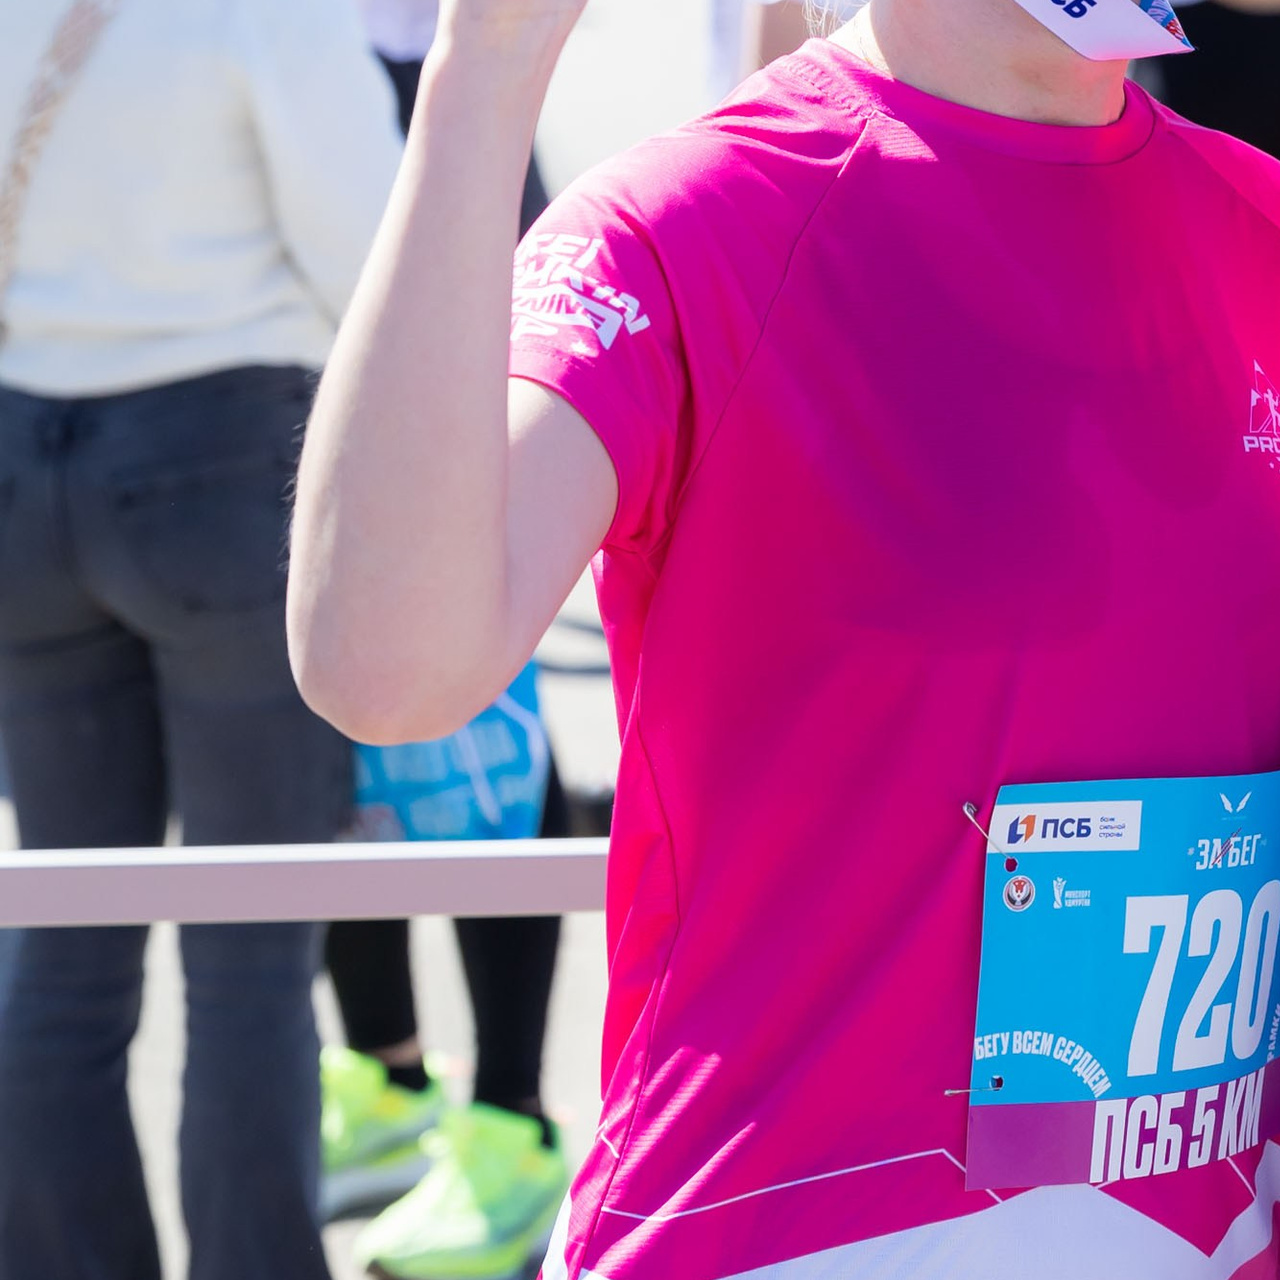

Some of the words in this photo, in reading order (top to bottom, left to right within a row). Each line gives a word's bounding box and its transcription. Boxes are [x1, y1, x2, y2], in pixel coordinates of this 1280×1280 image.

[1041, 817, 1092, 839] ПСБ
[974, 1031, 1010, 1061] БЕГУ
[1012, 1030, 1054, 1057] ВСЕМ
[1053, 1036, 1112, 1099] СЕРДЦЕМ
[1089, 1091, 1183, 1183] ПСБ
[1187, 1084, 1220, 1169] 5
[1217, 1066, 1265, 1161] КМ
